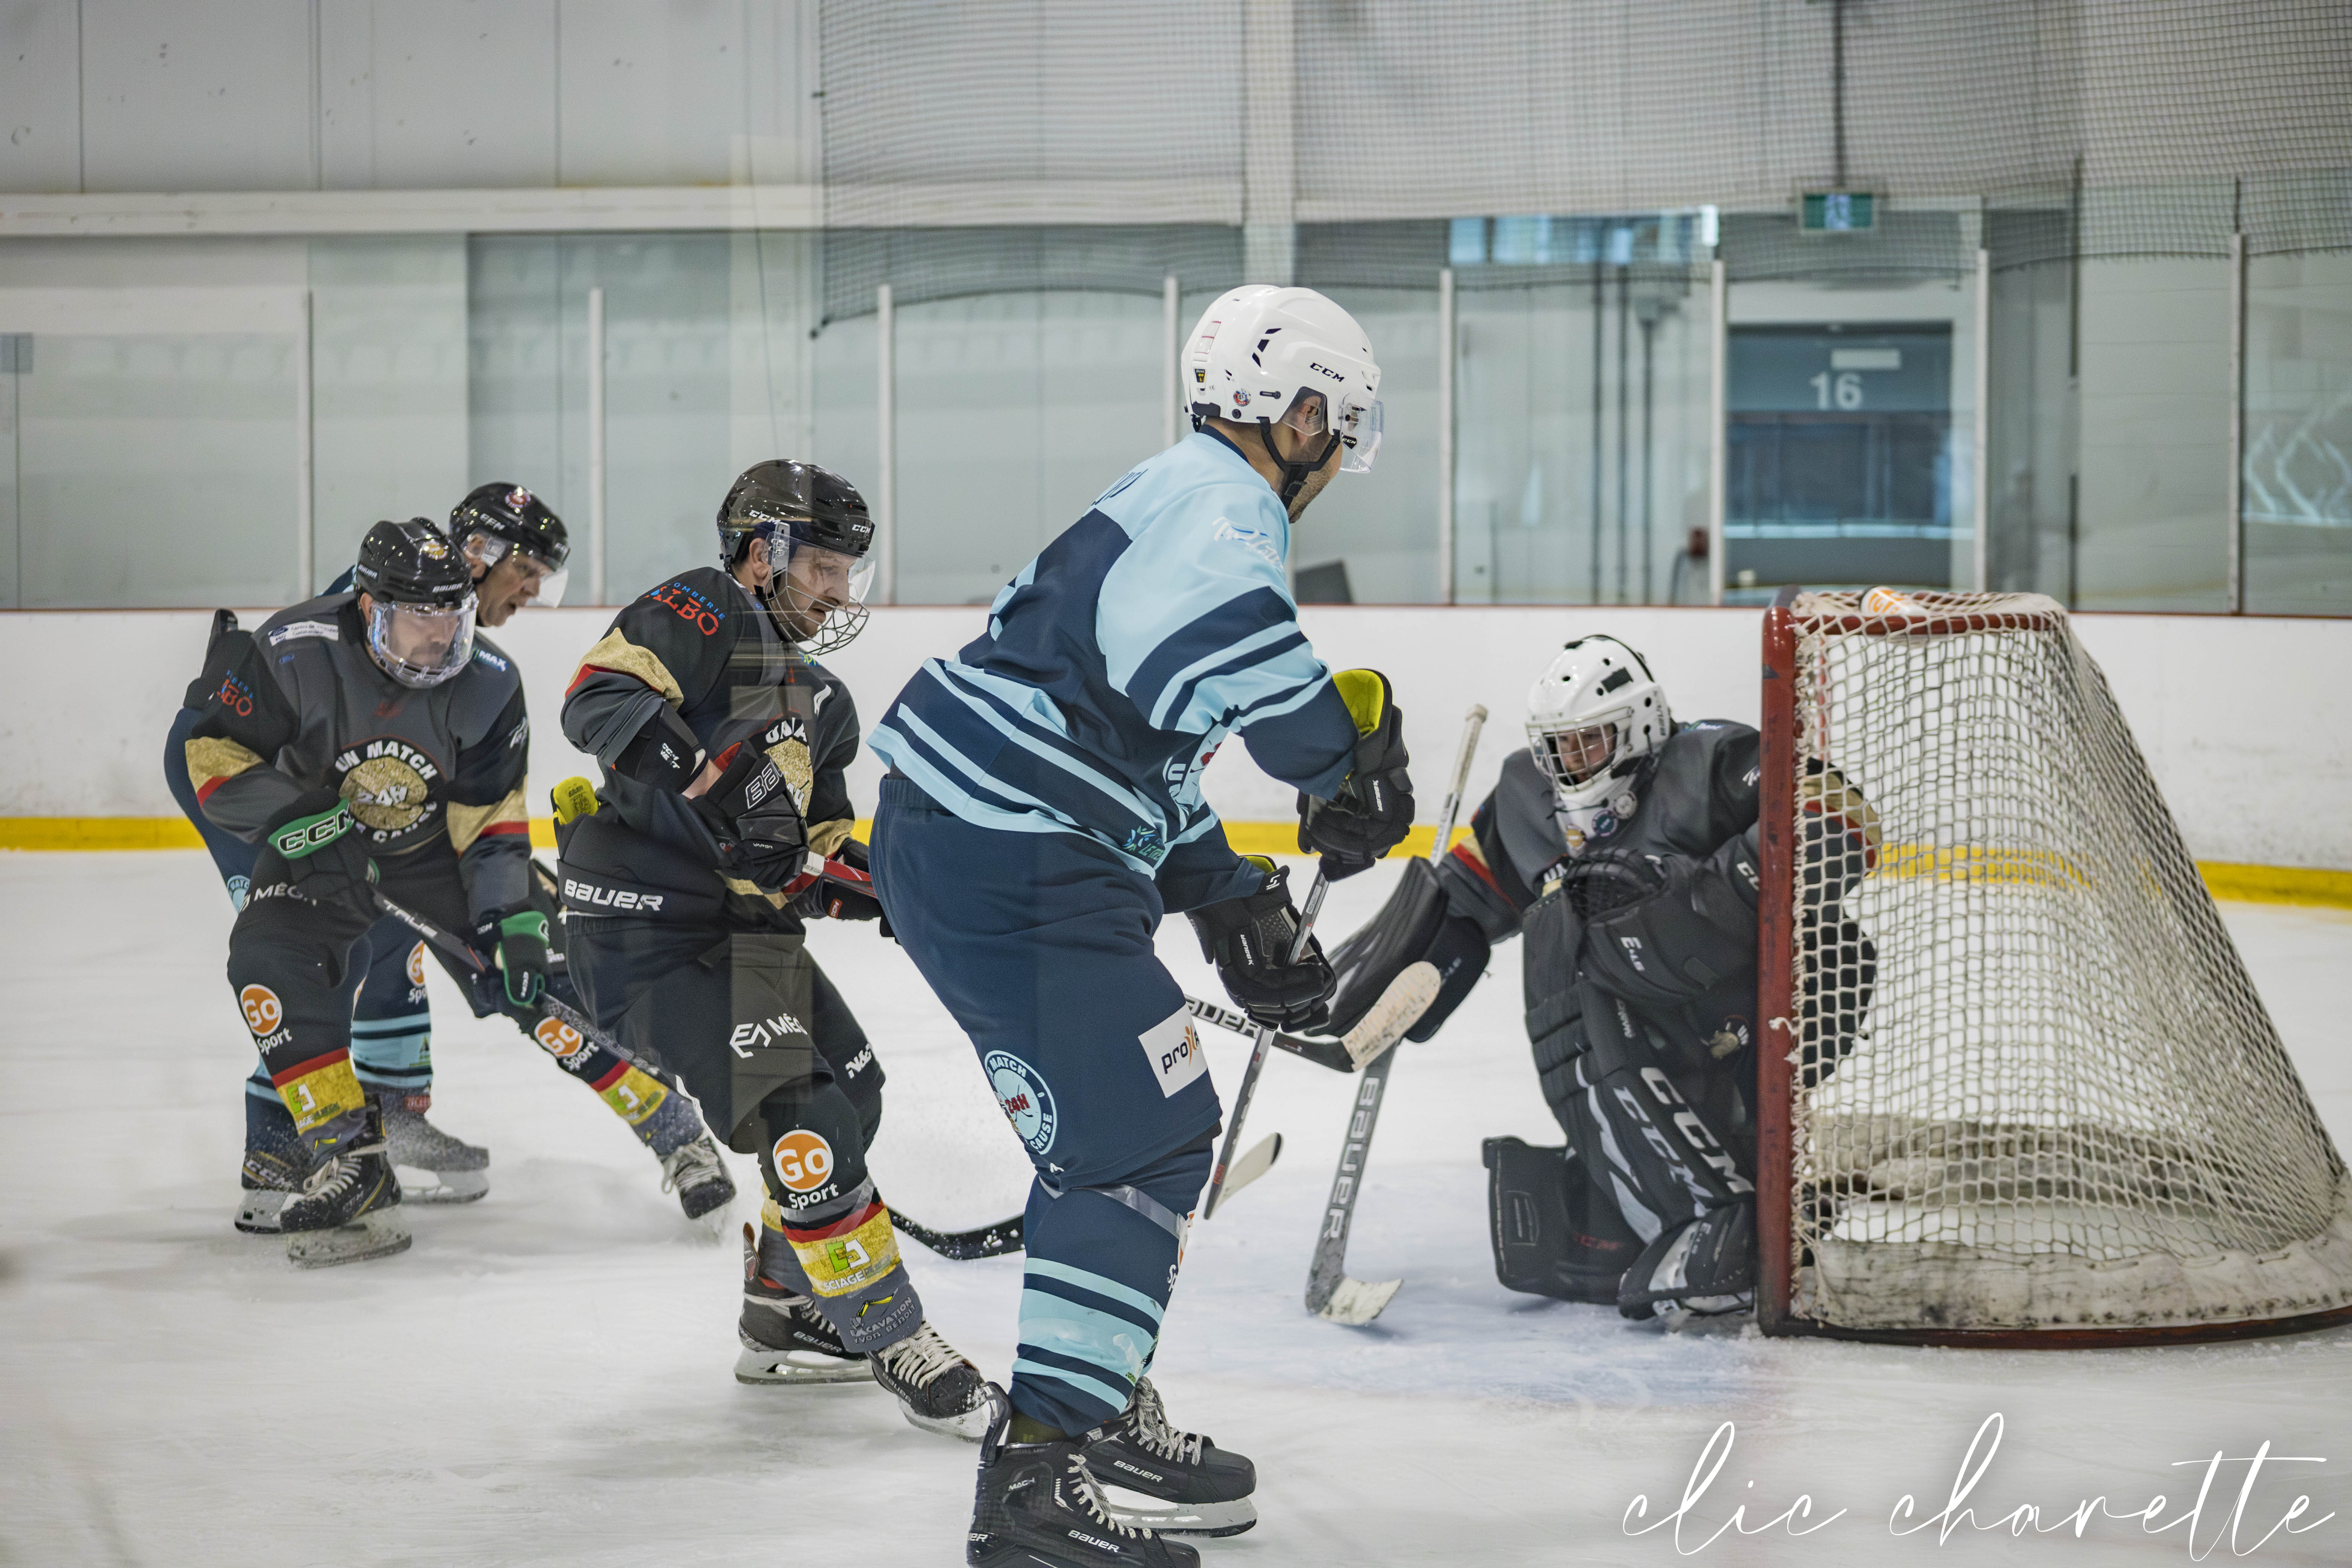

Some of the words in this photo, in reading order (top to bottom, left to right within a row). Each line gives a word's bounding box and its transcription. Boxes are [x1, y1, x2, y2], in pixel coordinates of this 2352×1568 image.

[1310, 362, 1345, 383] CCM
[1811, 371, 1863, 410] 16
[1342, 437, 1357, 445] CCM
[749, 510, 781, 525] CCM
[852, 524, 870, 534] CCM
[667, 582, 725, 620] OMBERIE
[335, 750, 361, 773] UN
[367, 740, 438, 780] MATCH
[357, 785, 407, 807] 24H
[564, 878, 663, 911] BAUER
[257, 1027, 292, 1055] Sport
[562, 1041, 600, 1072] Sport
[989, 1056, 1027, 1078] MATCH
[1004, 1093, 1031, 1114] 24H
[1029, 1112, 1053, 1150] CAUSE
[1640, 1067, 1756, 1194] CCM
[1322, 1076, 1380, 1240] BAUER
[788, 1182, 839, 1210] Sport
[823, 1270, 866, 1291] SCIAGE
[850, 1297, 912, 1337] EXCAVATION
[793, 1331, 842, 1353] BAUER
[1113, 1460, 1163, 1482] BAUER
[1008, 1477, 1035, 1491] MACH
[1067, 1530, 1120, 1553] BAUER
